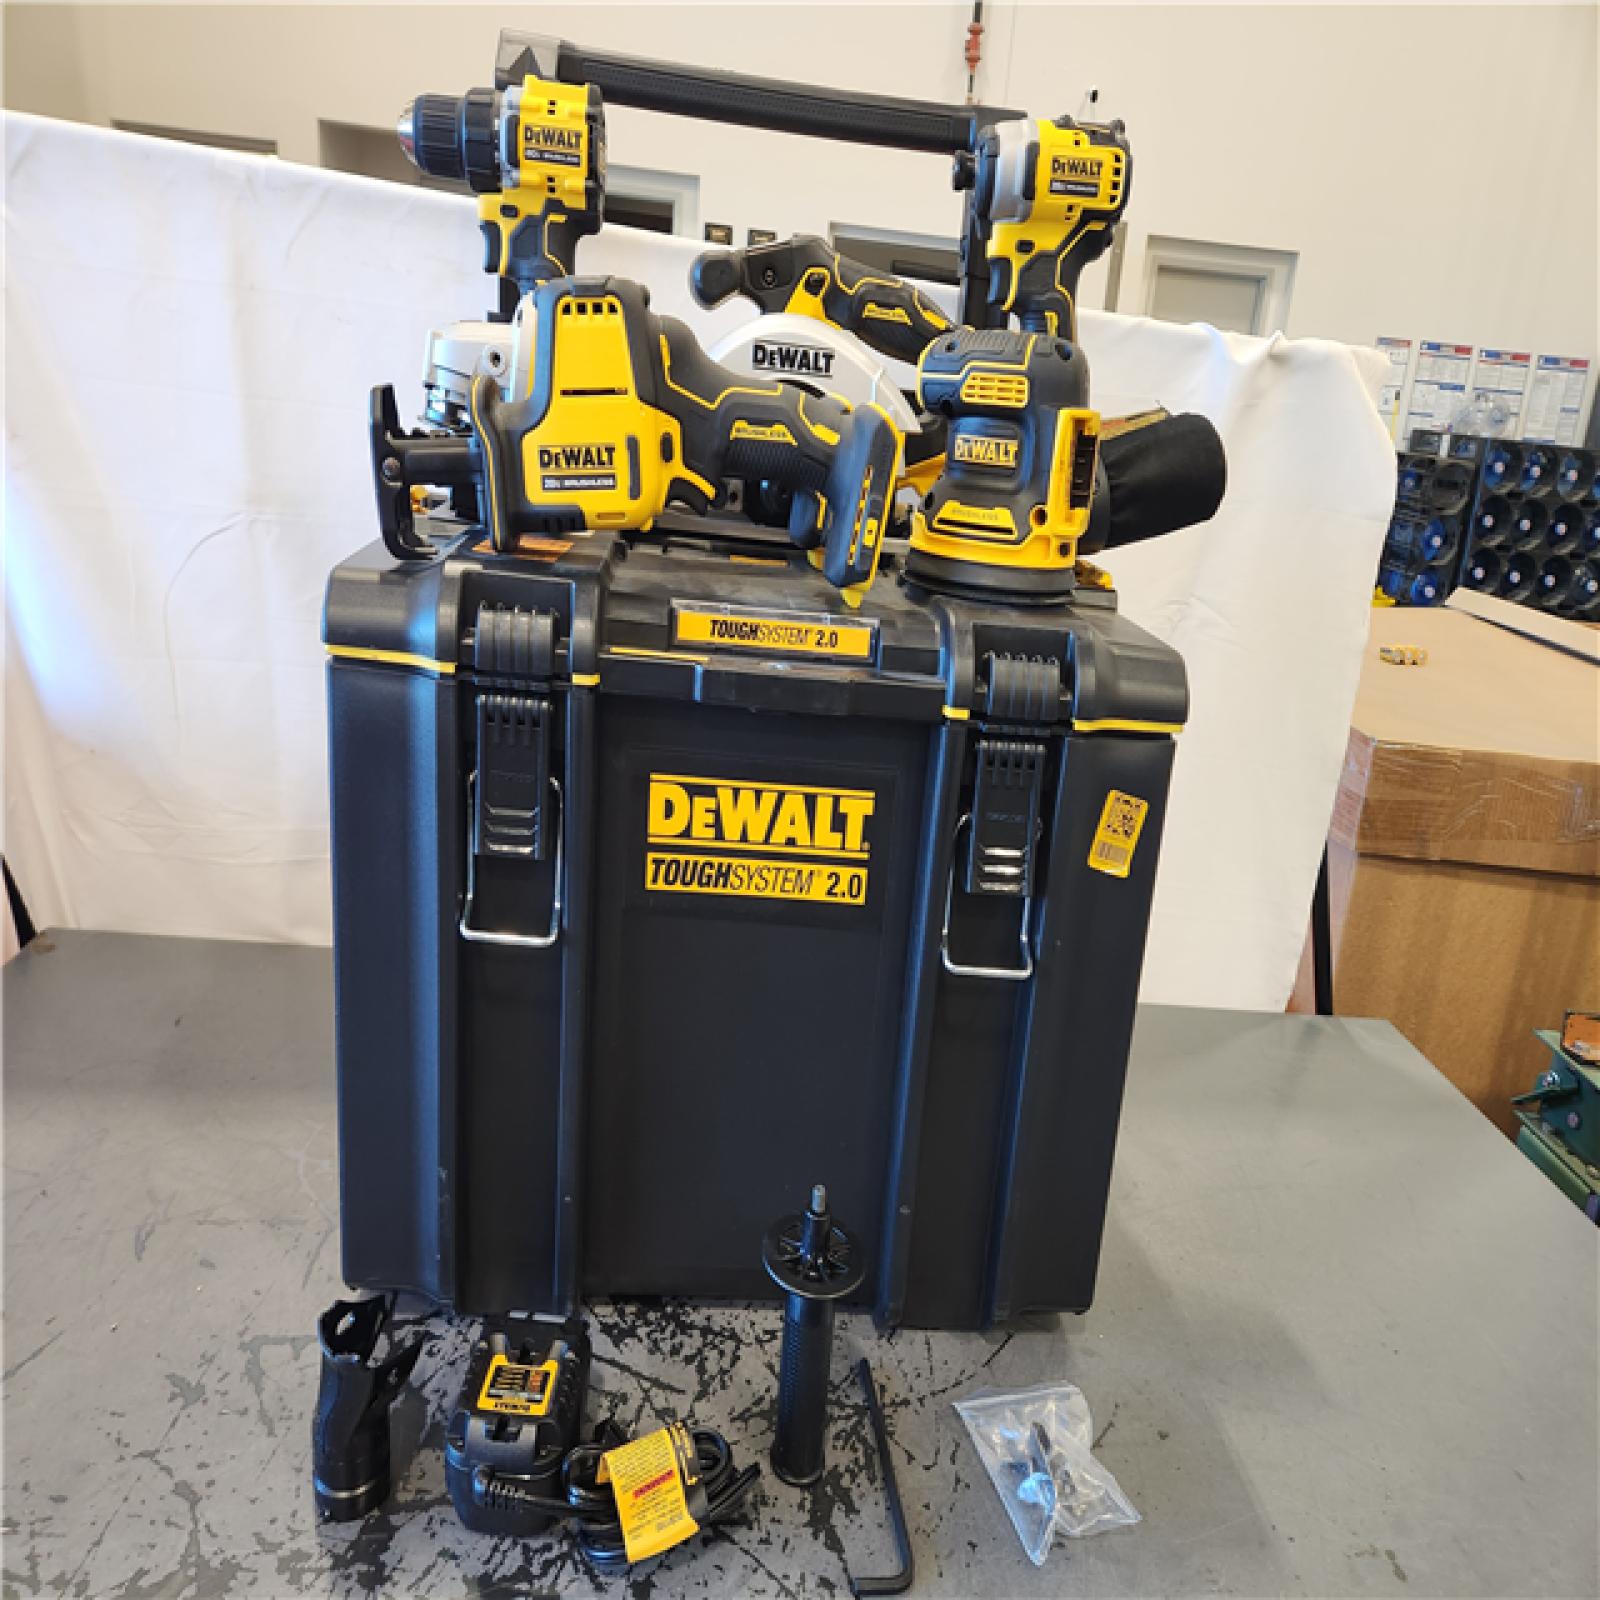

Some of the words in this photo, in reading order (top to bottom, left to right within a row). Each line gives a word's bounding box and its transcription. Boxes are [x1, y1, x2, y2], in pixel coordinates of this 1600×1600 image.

[754, 343, 835, 374] DEWALT
[815, 630, 838, 648] 2.0
[650, 782, 874, 850] DEWALT
[825, 872, 861, 899] 2.0
